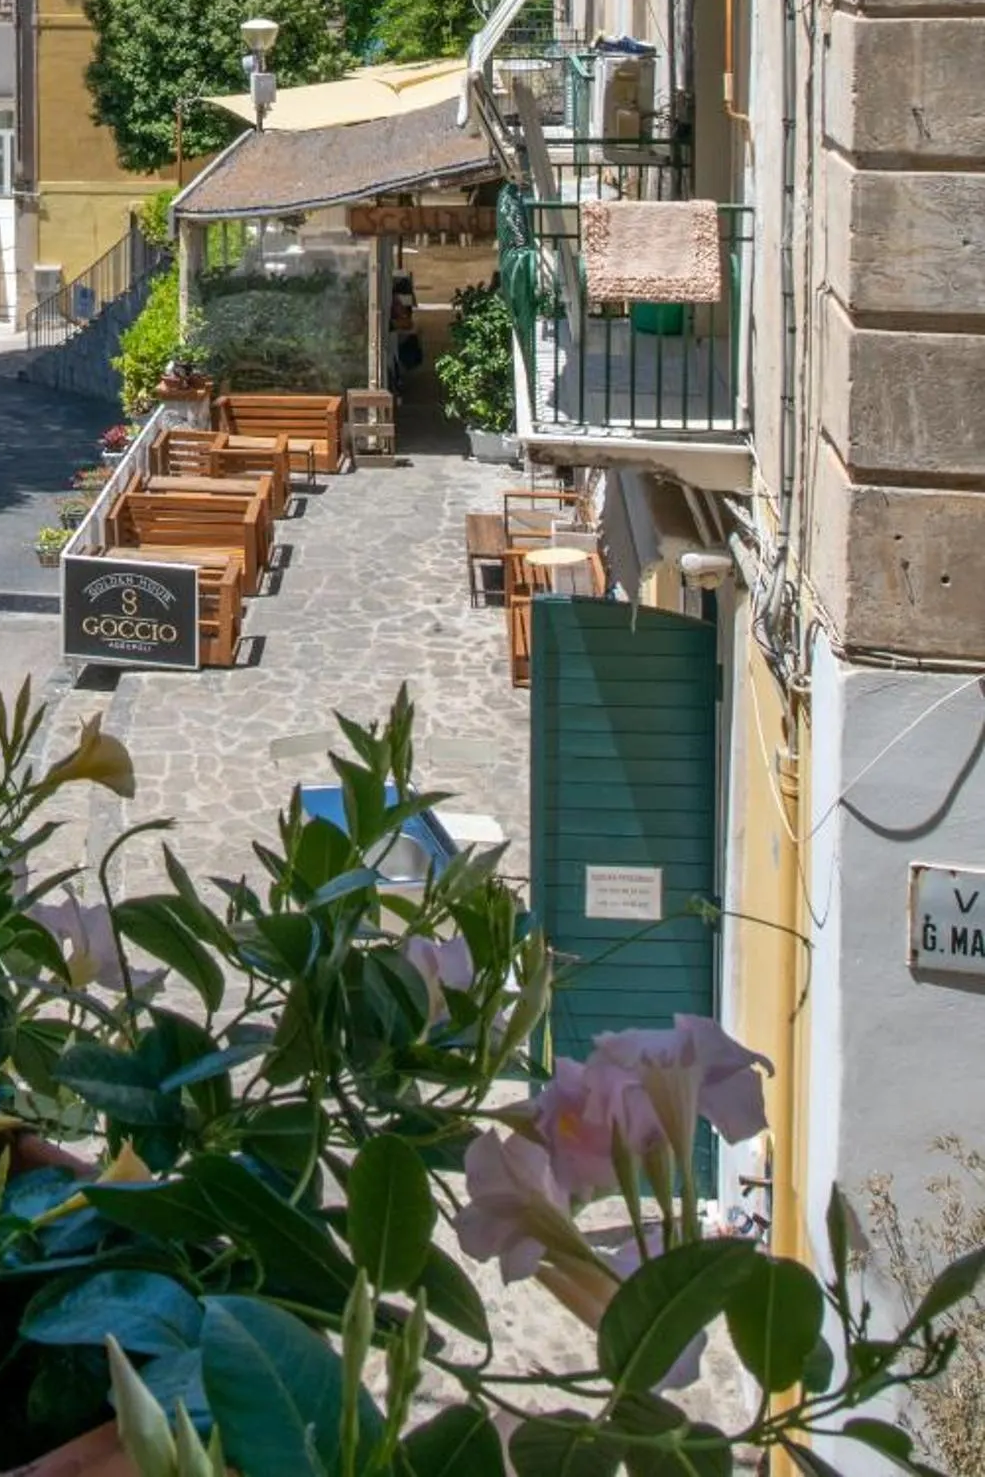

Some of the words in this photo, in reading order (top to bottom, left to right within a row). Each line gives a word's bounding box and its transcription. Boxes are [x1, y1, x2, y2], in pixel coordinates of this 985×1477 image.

[82, 616, 178, 643] GOCCIO
[953, 888, 980, 914] V
[922, 923, 945, 953] G.
[951, 925, 985, 958] MA
